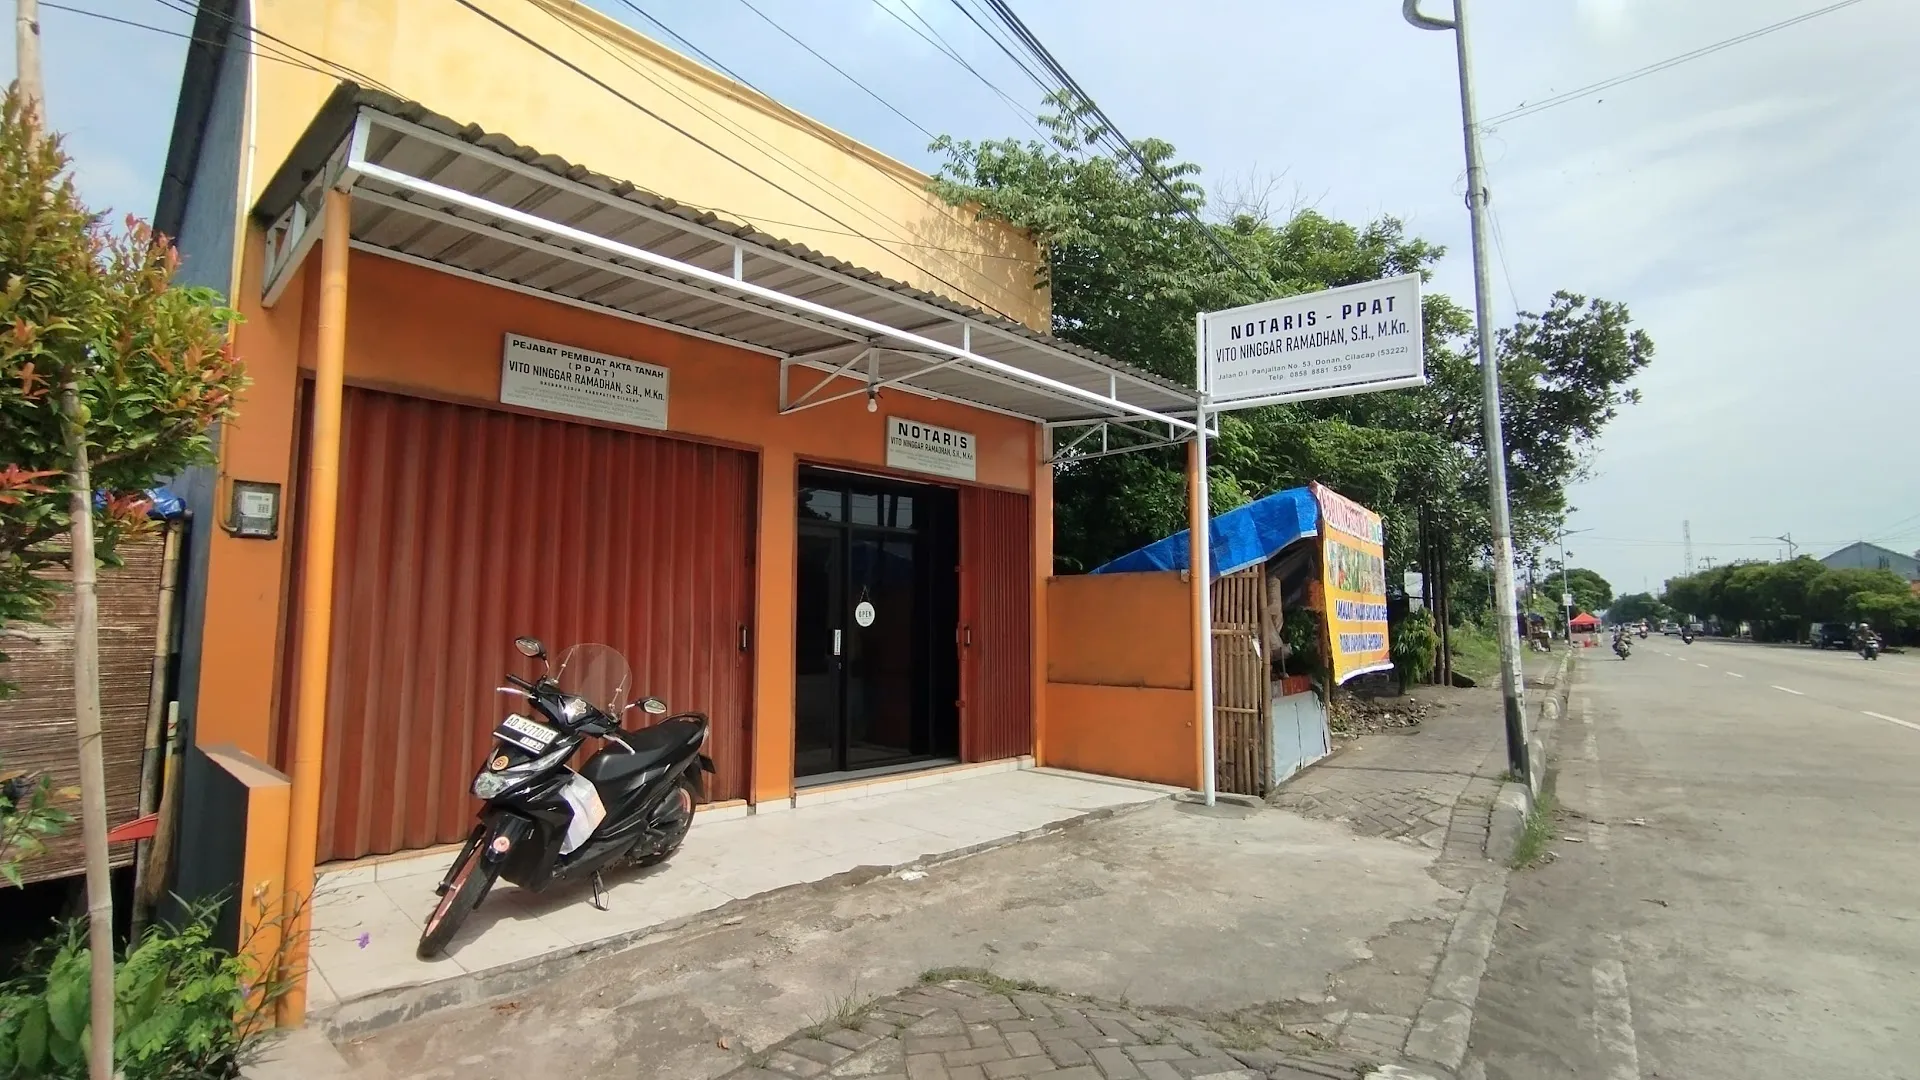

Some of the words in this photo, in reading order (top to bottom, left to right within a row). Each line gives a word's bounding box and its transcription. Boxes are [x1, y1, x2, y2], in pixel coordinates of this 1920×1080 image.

[1232, 311, 1316, 340] NOTARIS
[1342, 296, 1396, 320] PPAT
[1216, 346, 1236, 363] VITO
[1240, 339, 1282, 359] NINGGAR
[1286, 329, 1348, 352] RAMADHAN,
[1351, 325, 1374, 341] S.H.,
[1378, 319, 1409, 337] M.Kn.
[513, 340, 558, 356] PEJABAT
[562, 350, 606, 366] PEMBUAT
[610, 361, 631, 371] AKTA
[635, 366, 663, 378] TANAH
[1218, 372, 1236, 380] Jalan
[1345, 351, 1375, 361] Cilacap
[1378, 347, 1408, 358] (53222)
[1334, 364, 1352, 372] 5359
[509, 360, 529, 373] VITO
[533, 366, 571, 382] NINGGAR
[575, 373, 623, 394] RAMADHAN,
[626, 384, 642, 397] S.H.,
[645, 388, 664, 400] M.Kn.
[891, 437, 902, 445] VITO
[899, 423, 967, 448] NOTARIS
